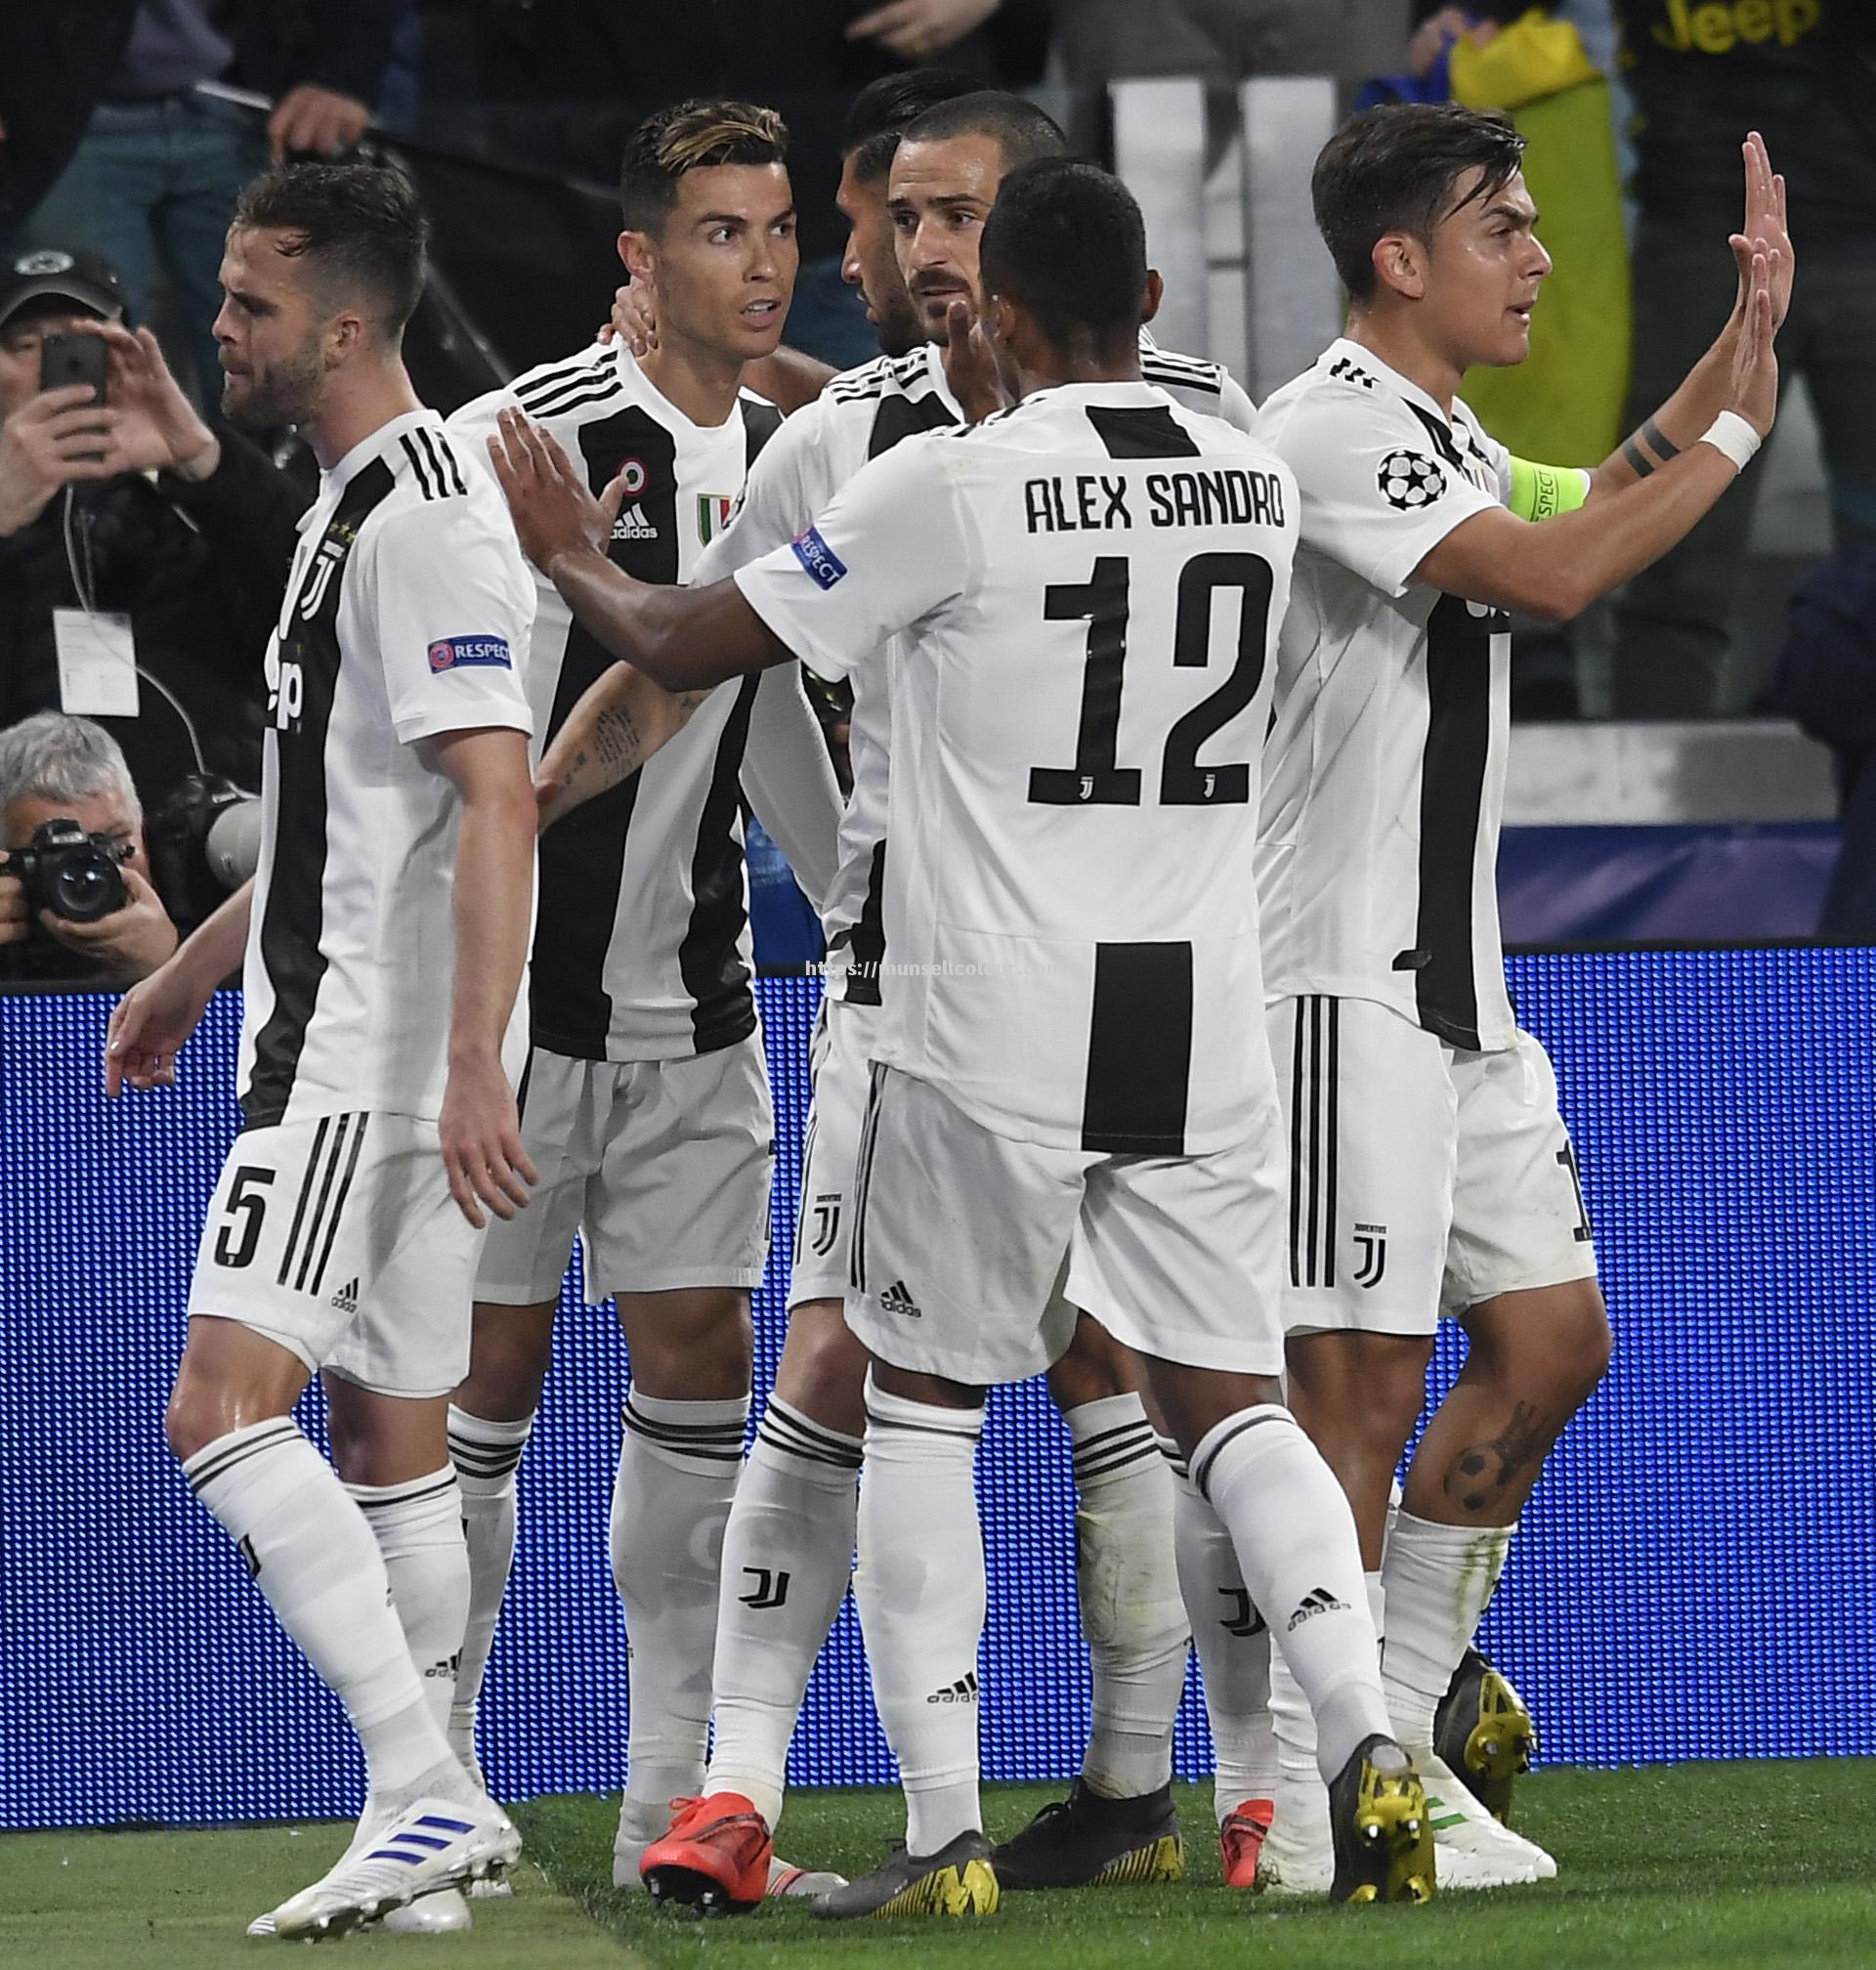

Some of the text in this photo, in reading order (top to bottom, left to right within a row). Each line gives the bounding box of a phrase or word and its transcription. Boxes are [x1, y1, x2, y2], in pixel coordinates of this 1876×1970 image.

[1651, 0, 1821, 55] Jeep
[610, 526, 658, 539] adidas
[1026, 470, 1285, 533] ALEX SANDRO
[1028, 551, 1274, 806] 12
[214, 1166, 277, 1268] 5
